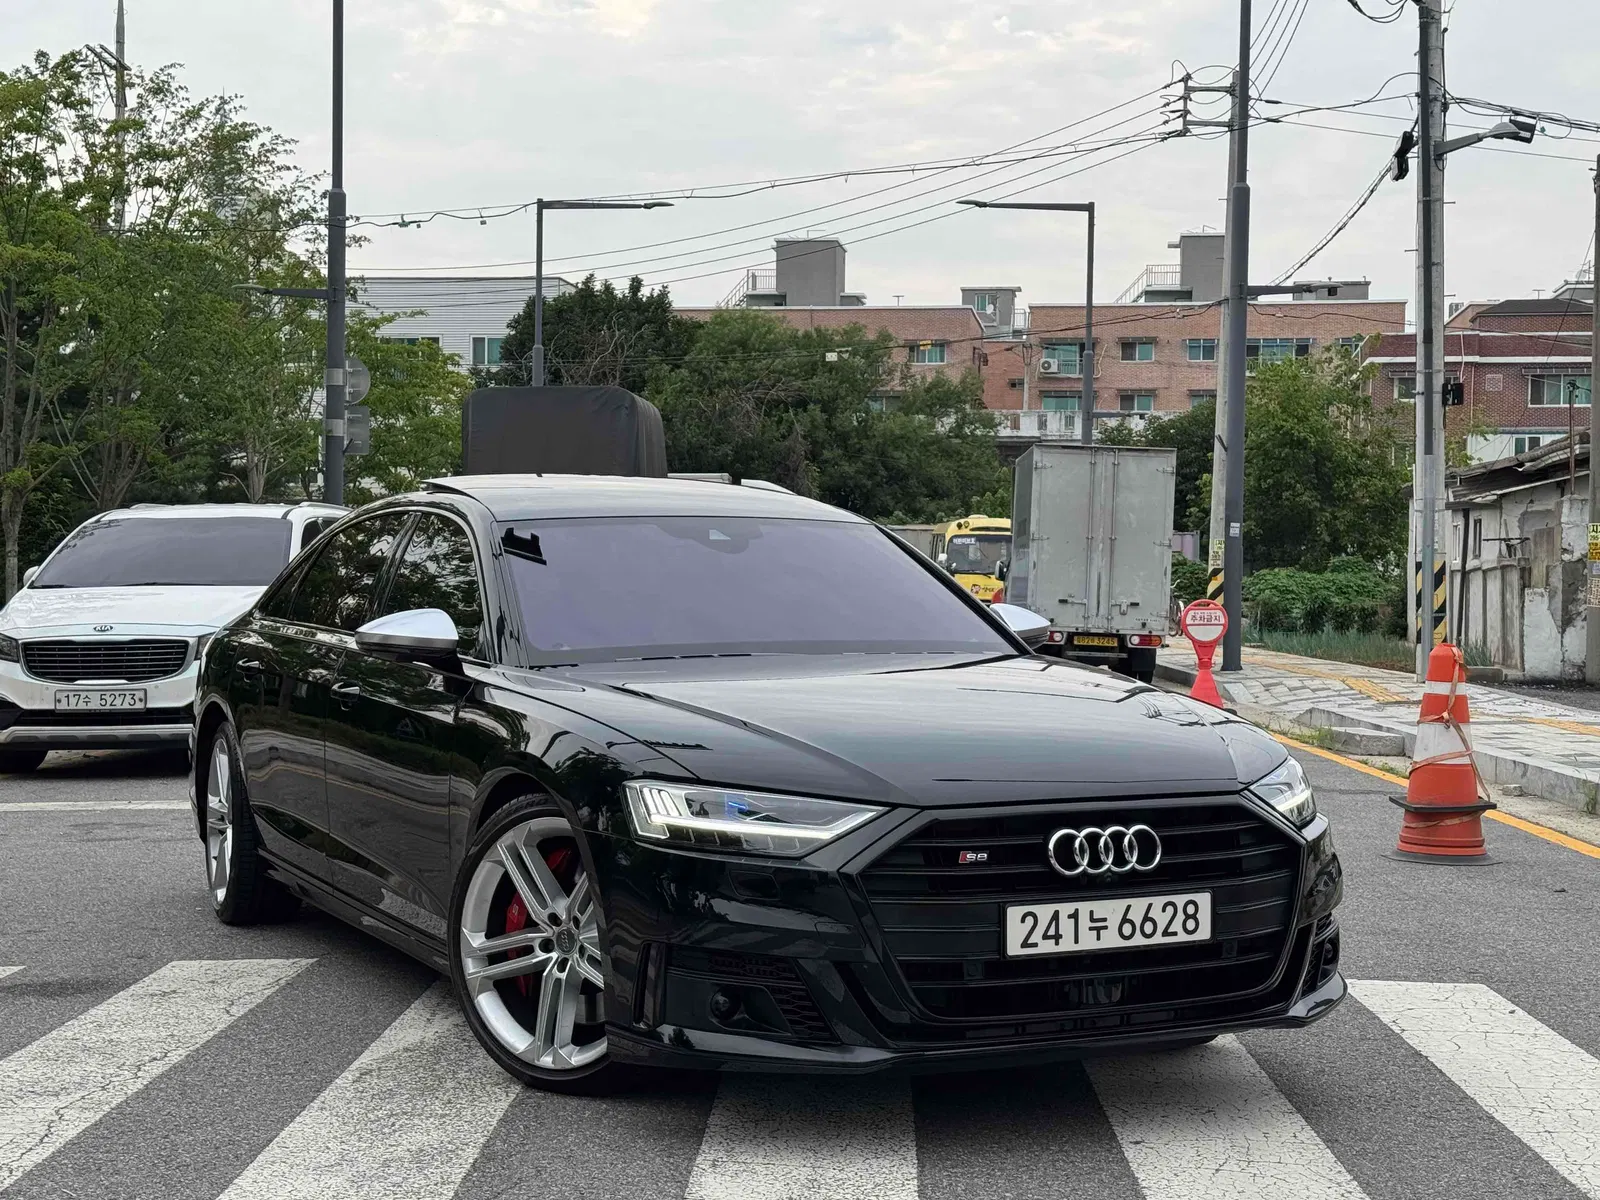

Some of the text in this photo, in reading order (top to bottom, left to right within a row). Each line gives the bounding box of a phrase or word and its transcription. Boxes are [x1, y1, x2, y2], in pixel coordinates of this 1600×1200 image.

[95, 624, 112, 632] KIA
[64, 692, 137, 707] 17수 5273
[966, 853, 988, 861] S8
